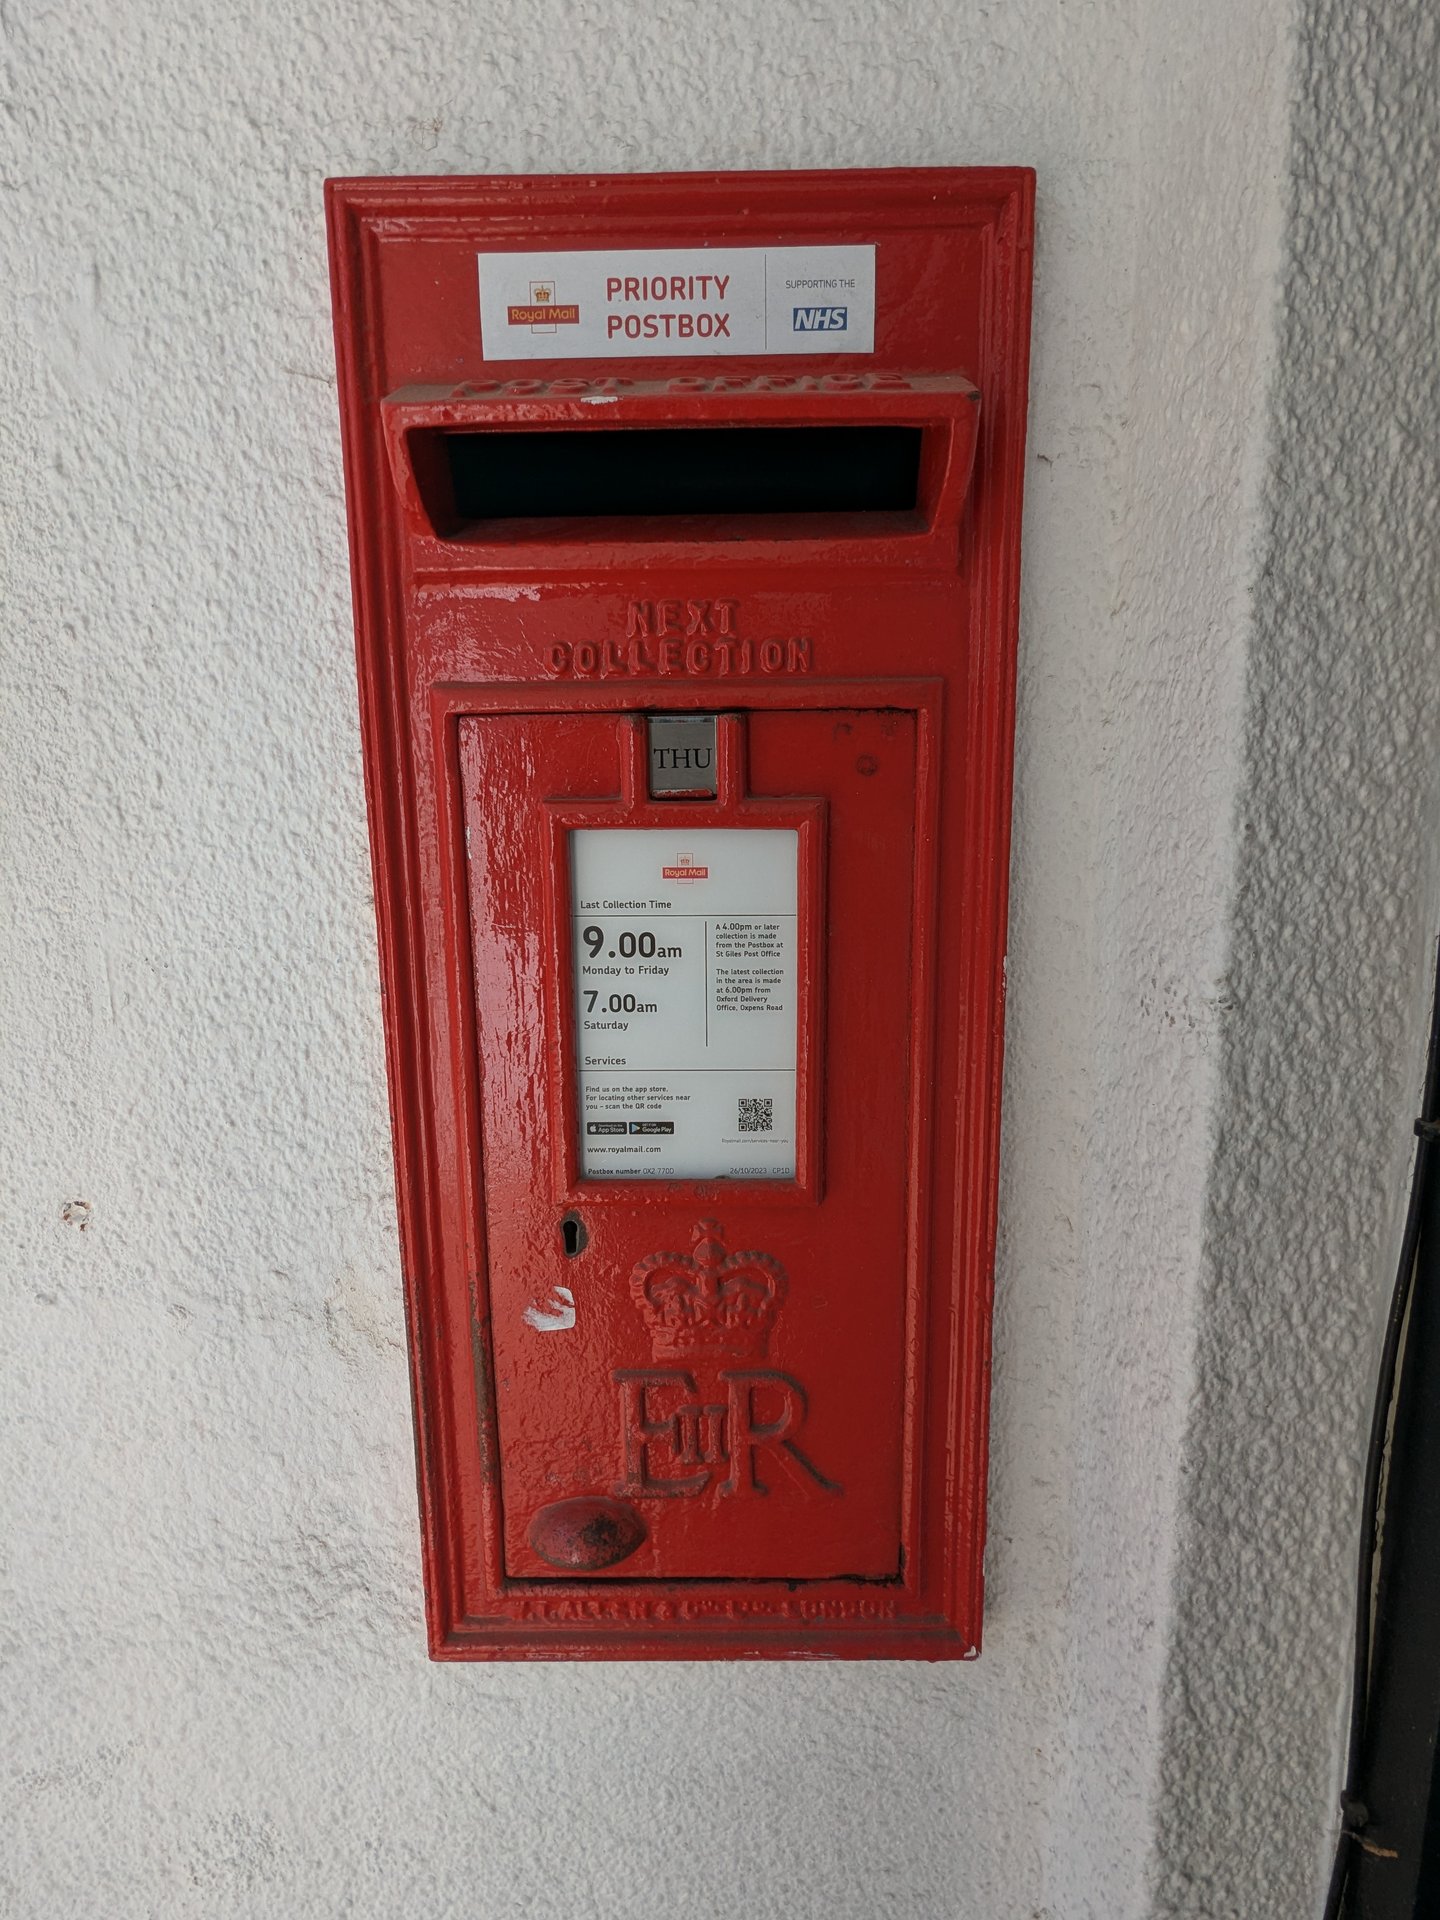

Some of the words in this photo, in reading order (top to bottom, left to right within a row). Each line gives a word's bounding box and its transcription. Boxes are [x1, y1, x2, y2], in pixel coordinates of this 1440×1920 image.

[606, 275, 730, 302] PRIORITY
[785, 279, 838, 289] SUPPORTING
[839, 278, 856, 288] THE
[511, 308, 546, 323] Royal
[548, 307, 576, 320] Mail
[794, 308, 847, 330] NHS
[607, 313, 731, 339] POSTBOX
[450, 377, 635, 398] POST
[667, 373, 912, 393] OFFICE
[626, 599, 741, 638] NEXT
[549, 636, 814, 678] COLLECTION
[653, 747, 713, 770] THU
[664, 868, 688, 878] Royal
[688, 868, 706, 876] Mail
[580, 900, 600, 909] Last
[602, 900, 647, 909] Collection
[649, 900, 672, 909] Time
[715, 923, 721, 931] A
[722, 922, 752, 932] 4.00pm
[763, 923, 780, 931] later
[715, 932, 748, 940] collection
[750, 932, 756, 940] is
[757, 932, 777, 940] made
[582, 925, 682, 959] 9.00am
[715, 941, 733, 949] from
[734, 941, 746, 949] the
[747, 941, 775, 949] Postbox
[776, 941, 784, 949] at
[715, 950, 724, 958] St
[725, 950, 742, 958] Giles
[744, 950, 759, 958] Post
[760, 950, 781, 958] Office
[582, 966, 622, 976] Monday
[625, 966, 635, 975] to
[638, 966, 669, 976] Friday
[715, 968, 729, 976] The
[730, 968, 750, 976] latest
[752, 968, 784, 976] collection
[715, 976, 723, 984] in
[754, 976, 761, 984] is
[725, 986, 753, 995] 6.00pm
[754, 986, 771, 994] from
[583, 990, 658, 1013] 7.00am
[716, 995, 738, 1003] Oxford
[740, 995, 768, 1004] Delivery
[740, 1004, 765, 1012] Oxpens
[584, 1021, 629, 1031] Saturday
[584, 1056, 627, 1066] Services
[598, 1094, 625, 1102] locating
[641, 1126, 661, 1134] Google
[587, 1146, 662, 1154] www.royalmail.com
[729, 1167, 768, 1175] 26/10/2023
